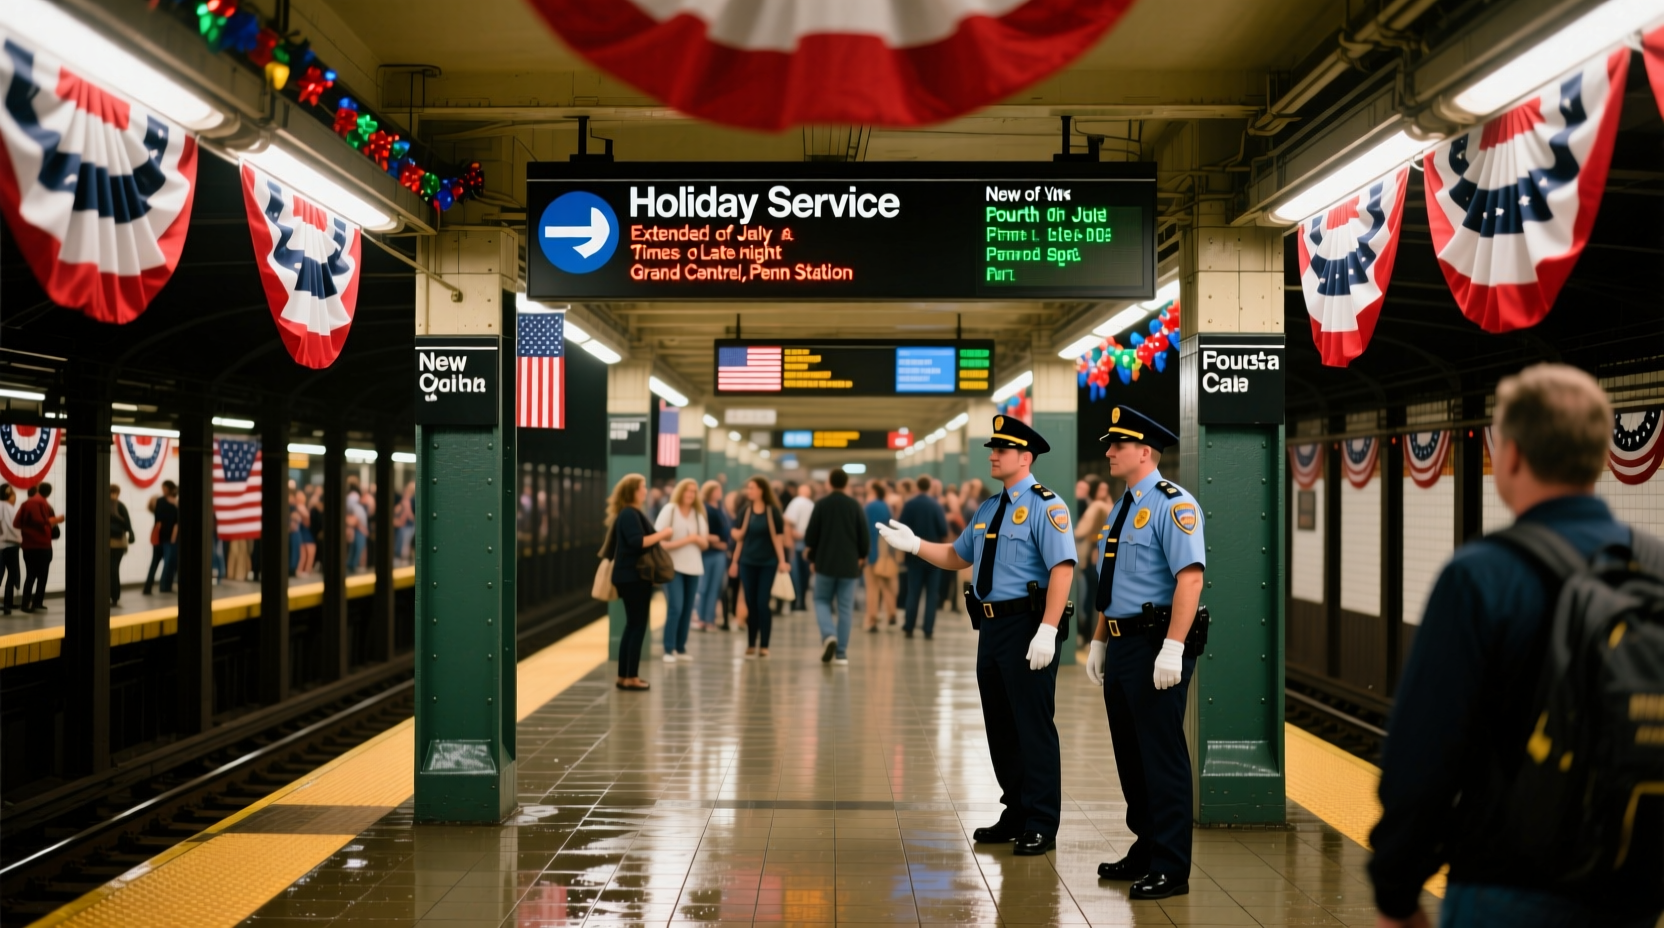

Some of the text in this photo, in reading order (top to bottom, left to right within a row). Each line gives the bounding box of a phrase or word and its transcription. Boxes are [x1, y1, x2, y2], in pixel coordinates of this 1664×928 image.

[986, 186, 1021, 202] New
[1025, 186, 1041, 202] of
[630, 186, 900, 225] Holiday Service
[631, 224, 710, 242] Extended
[715, 224, 734, 242] of
[630, 243, 681, 260] Times
[700, 243, 736, 260] Late
[739, 244, 782, 263] night
[630, 263, 680, 280] Grand
[750, 263, 790, 280] Penn
[794, 262, 853, 281] Station
[419, 351, 467, 372] New
